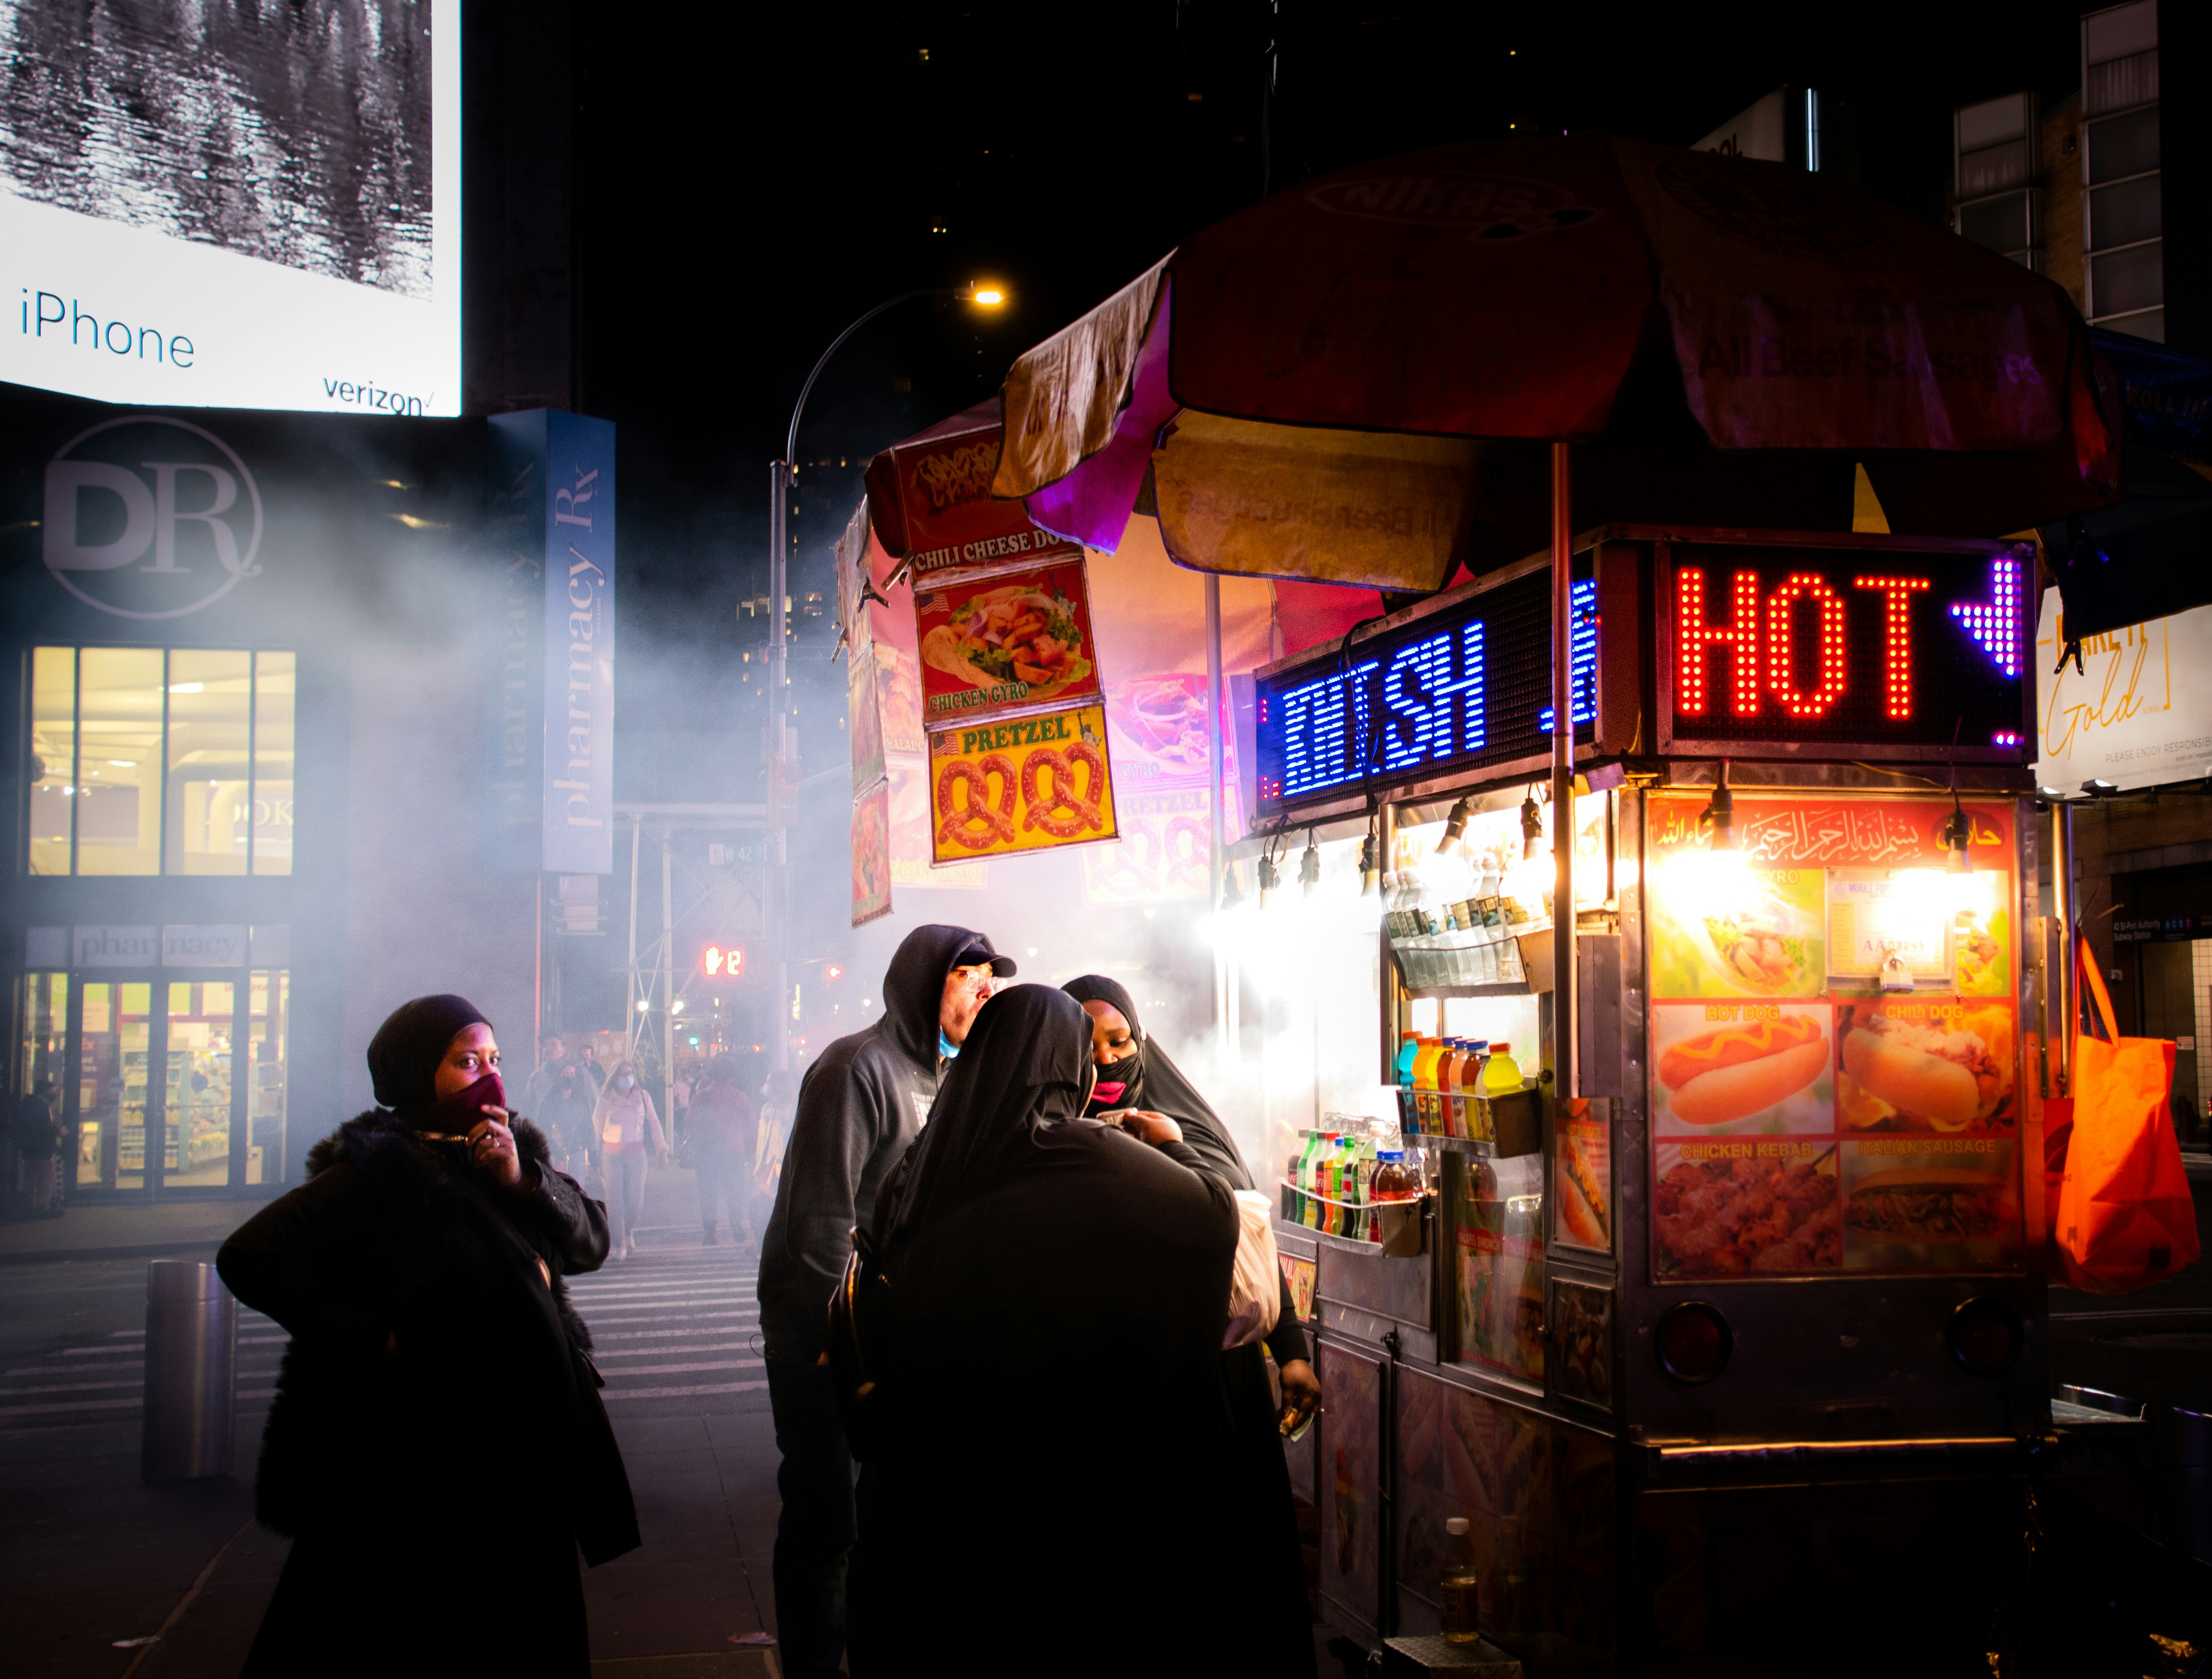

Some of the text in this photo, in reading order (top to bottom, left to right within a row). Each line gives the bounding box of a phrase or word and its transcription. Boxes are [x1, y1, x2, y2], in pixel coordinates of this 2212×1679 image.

[1343, 177, 1538, 217] NIKAS
[21, 288, 195, 368] iPhone
[1699, 336, 1751, 377] All
[1761, 336, 1854, 378] Beef
[323, 377, 423, 417] verizon
[2125, 386, 2176, 414] ROLL
[42, 459, 264, 577] DR
[914, 529, 1069, 572] CHILI CHEESE DO
[1678, 568, 1931, 718] HOT
[553, 542, 607, 831] pharmacy
[929, 687, 988, 713] CHICKEN
[991, 682, 1029, 704] GYRO
[2046, 641, 2148, 759] Gold
[962, 717, 1071, 755] PRETZEL
[2106, 736, 2212, 763] PLEASE ENJOY RESPONSIB
[1120, 761, 1160, 780] GYRO
[1118, 792, 1208, 816] RETZEL
[738, 846, 753, 862] 42
[2114, 931, 2152, 942] Subway Station
[2138, 920, 2161, 930] Authority
[80, 928, 239, 964] pharmacy
[1705, 1005, 1780, 1021] HOT DOG
[1886, 1005, 1964, 1020] CHILI DOG
[1680, 1142, 1813, 1160] CHICKEN KEBAB
[1859, 1140, 1996, 1156] ITALIAN SAUSAGE
